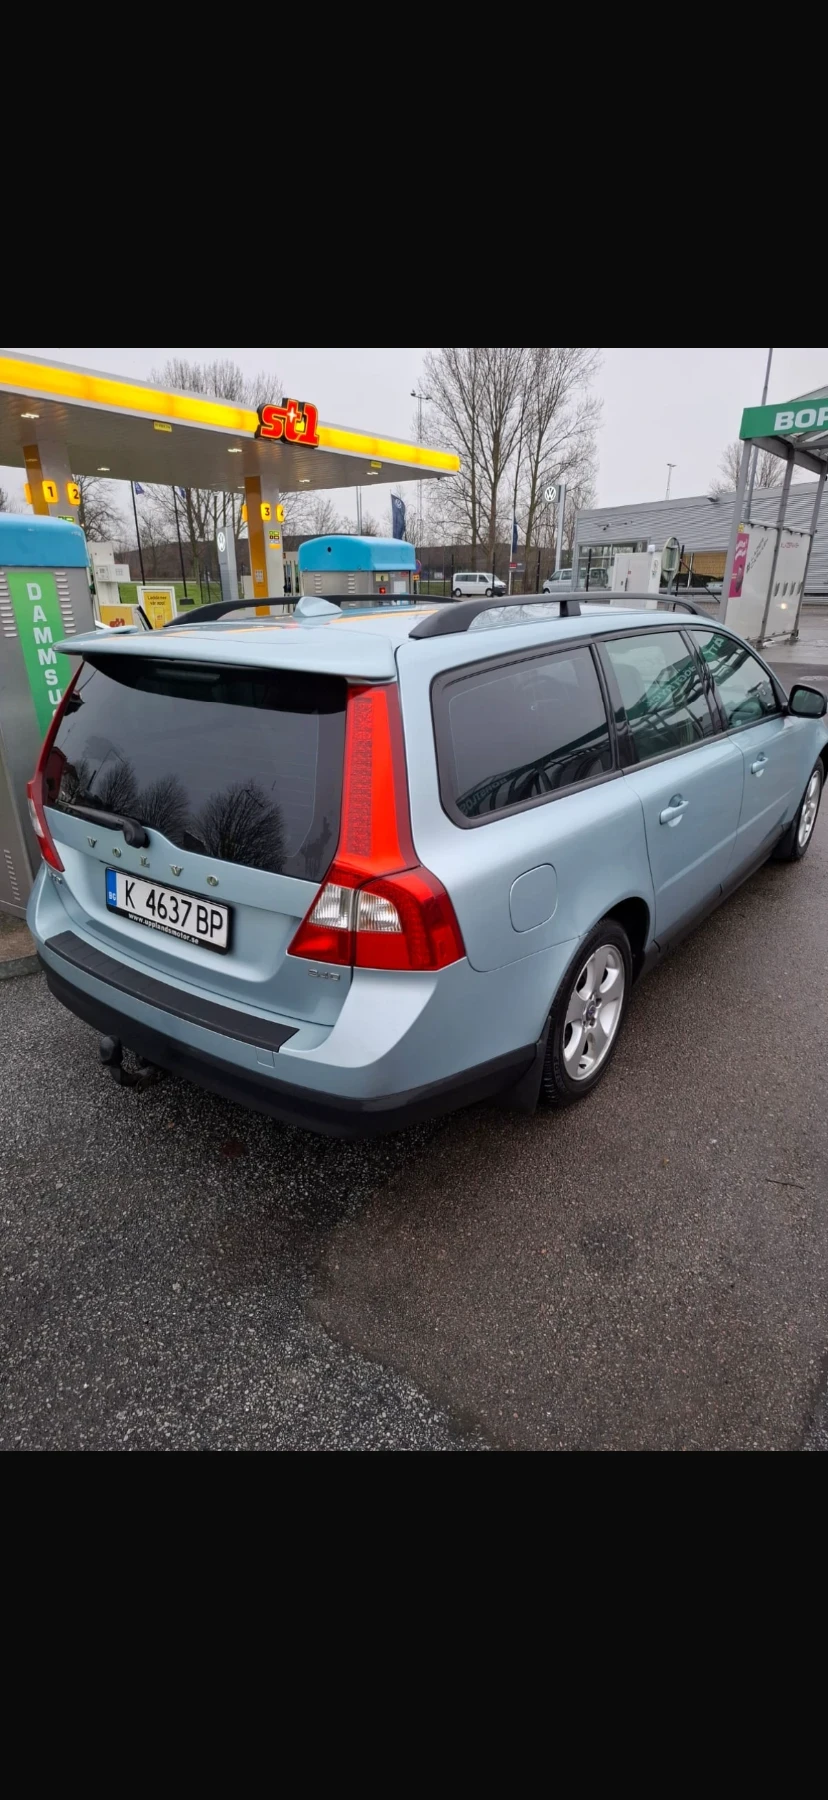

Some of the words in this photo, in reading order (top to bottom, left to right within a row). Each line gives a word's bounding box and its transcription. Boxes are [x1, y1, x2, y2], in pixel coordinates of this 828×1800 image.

[260, 398, 319, 446] st1
[47, 486, 54, 498] 1
[72, 488, 80, 500] 2
[264, 507, 271, 517] 3
[26, 582, 64, 717] DAMMSU
[86, 836, 220, 887] VOLVO
[108, 891, 117, 901] BG
[125, 879, 136, 910] K
[145, 888, 193, 928] 4637
[196, 904, 224, 939] BP
[128, 912, 200, 945] www.upplandsmotor.se
